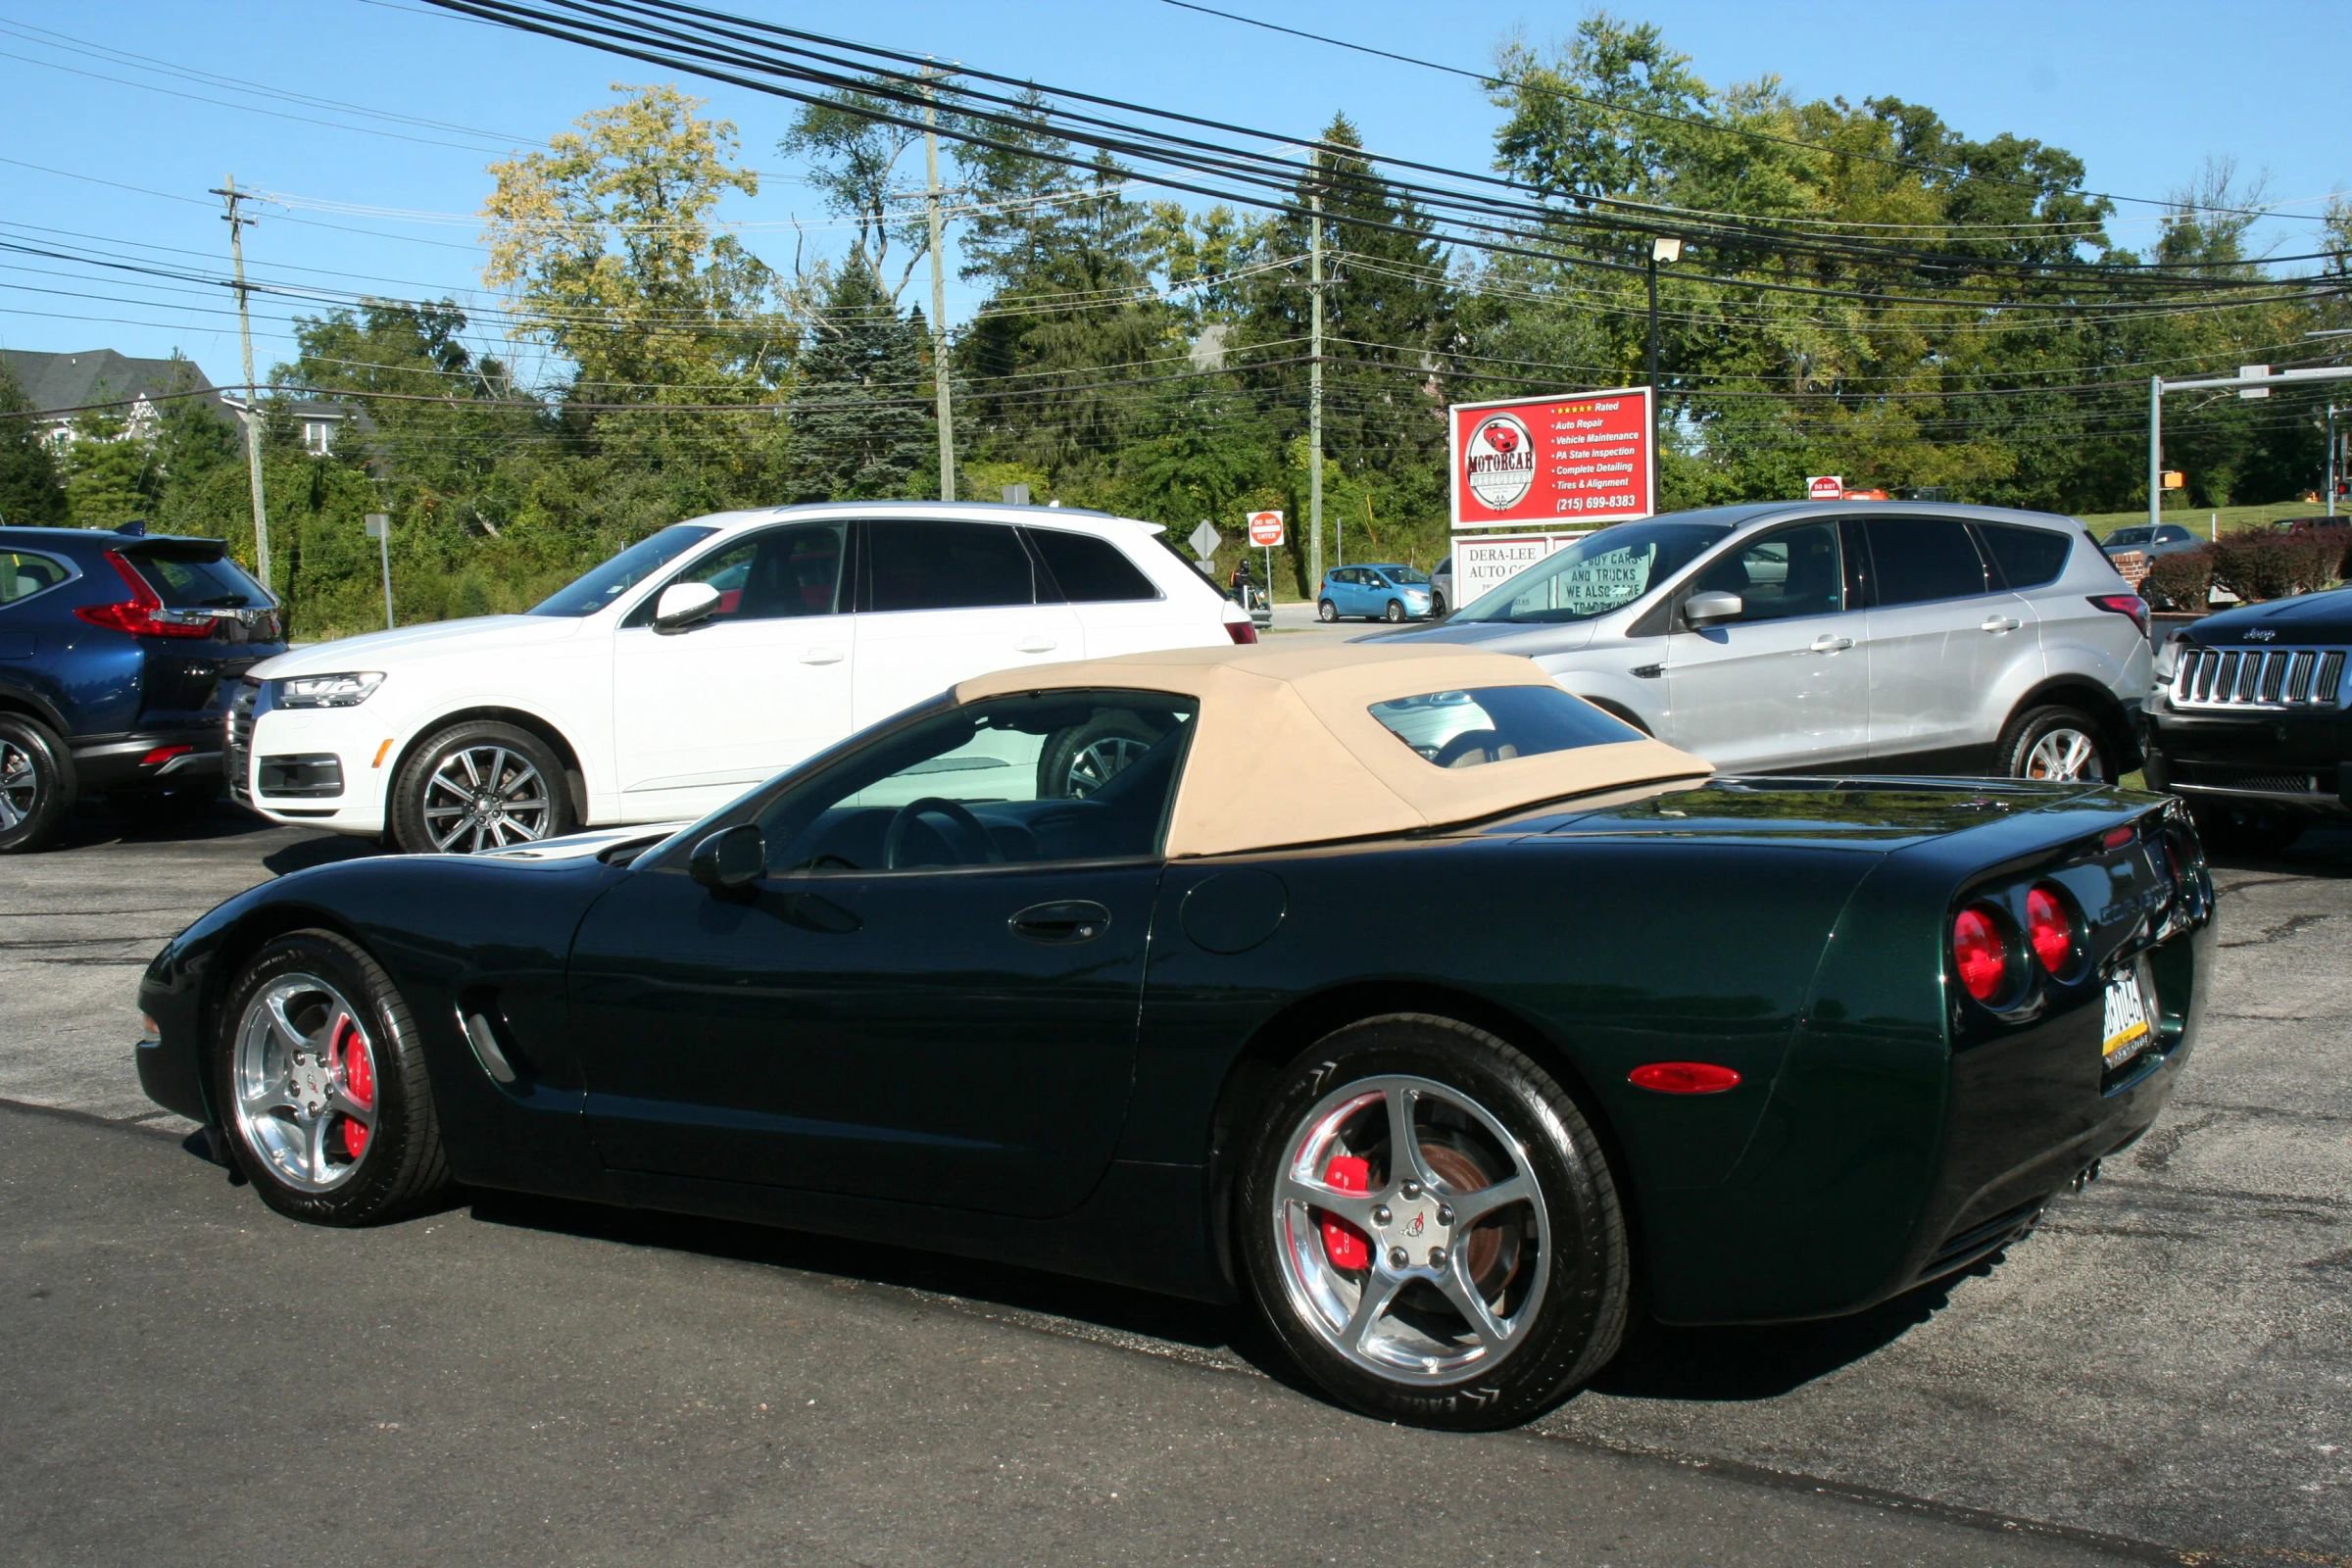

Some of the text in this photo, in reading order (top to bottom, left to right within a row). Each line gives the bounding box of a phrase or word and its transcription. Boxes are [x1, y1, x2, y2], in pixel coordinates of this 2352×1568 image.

[1594, 402, 1619, 413] Rated
[1555, 418, 1603, 430] Auto Repair
[1556, 431, 1640, 445] Vehicle Maintenance
[1555, 446, 1635, 460] PA State Inspection
[1467, 452, 1534, 473] MOTORCAR
[1556, 463, 1633, 477] Complete Detailing
[1557, 477, 1629, 490] Tires & Alignment
[1556, 495, 1636, 513] (215) 699-8383
[1469, 548, 1537, 563] DERA-LEE
[1469, 565, 1506, 578] AUTO
[1595, 568, 1636, 581] TRUCKS
[1566, 585, 1582, 598] WE
[1585, 585, 1610, 598] ALSO
[2243, 627, 2276, 642] Jeep
